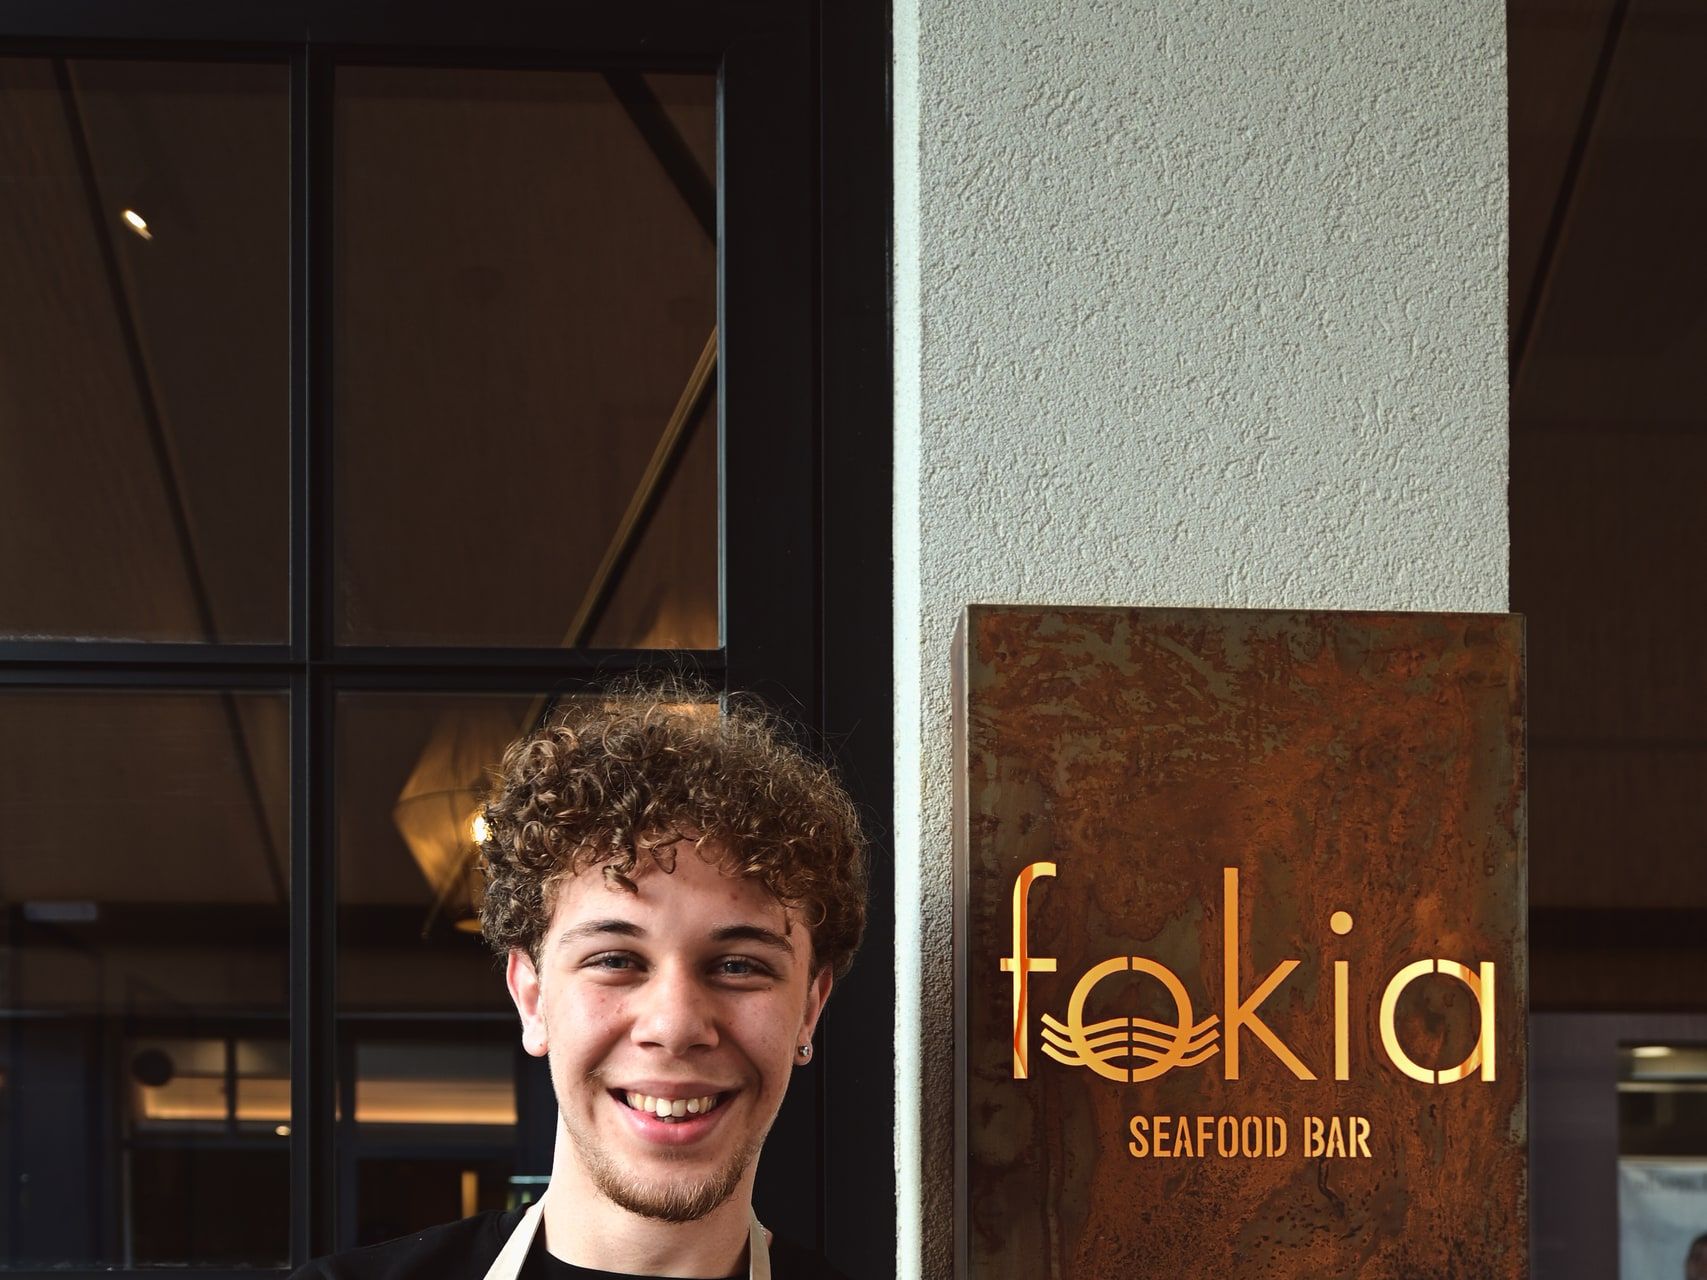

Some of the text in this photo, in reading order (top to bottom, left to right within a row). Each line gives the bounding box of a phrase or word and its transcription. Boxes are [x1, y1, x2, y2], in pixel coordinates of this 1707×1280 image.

[1000, 861, 1496, 1084] fokia
[1128, 1115, 1372, 1159] SEAFOOD BAR
